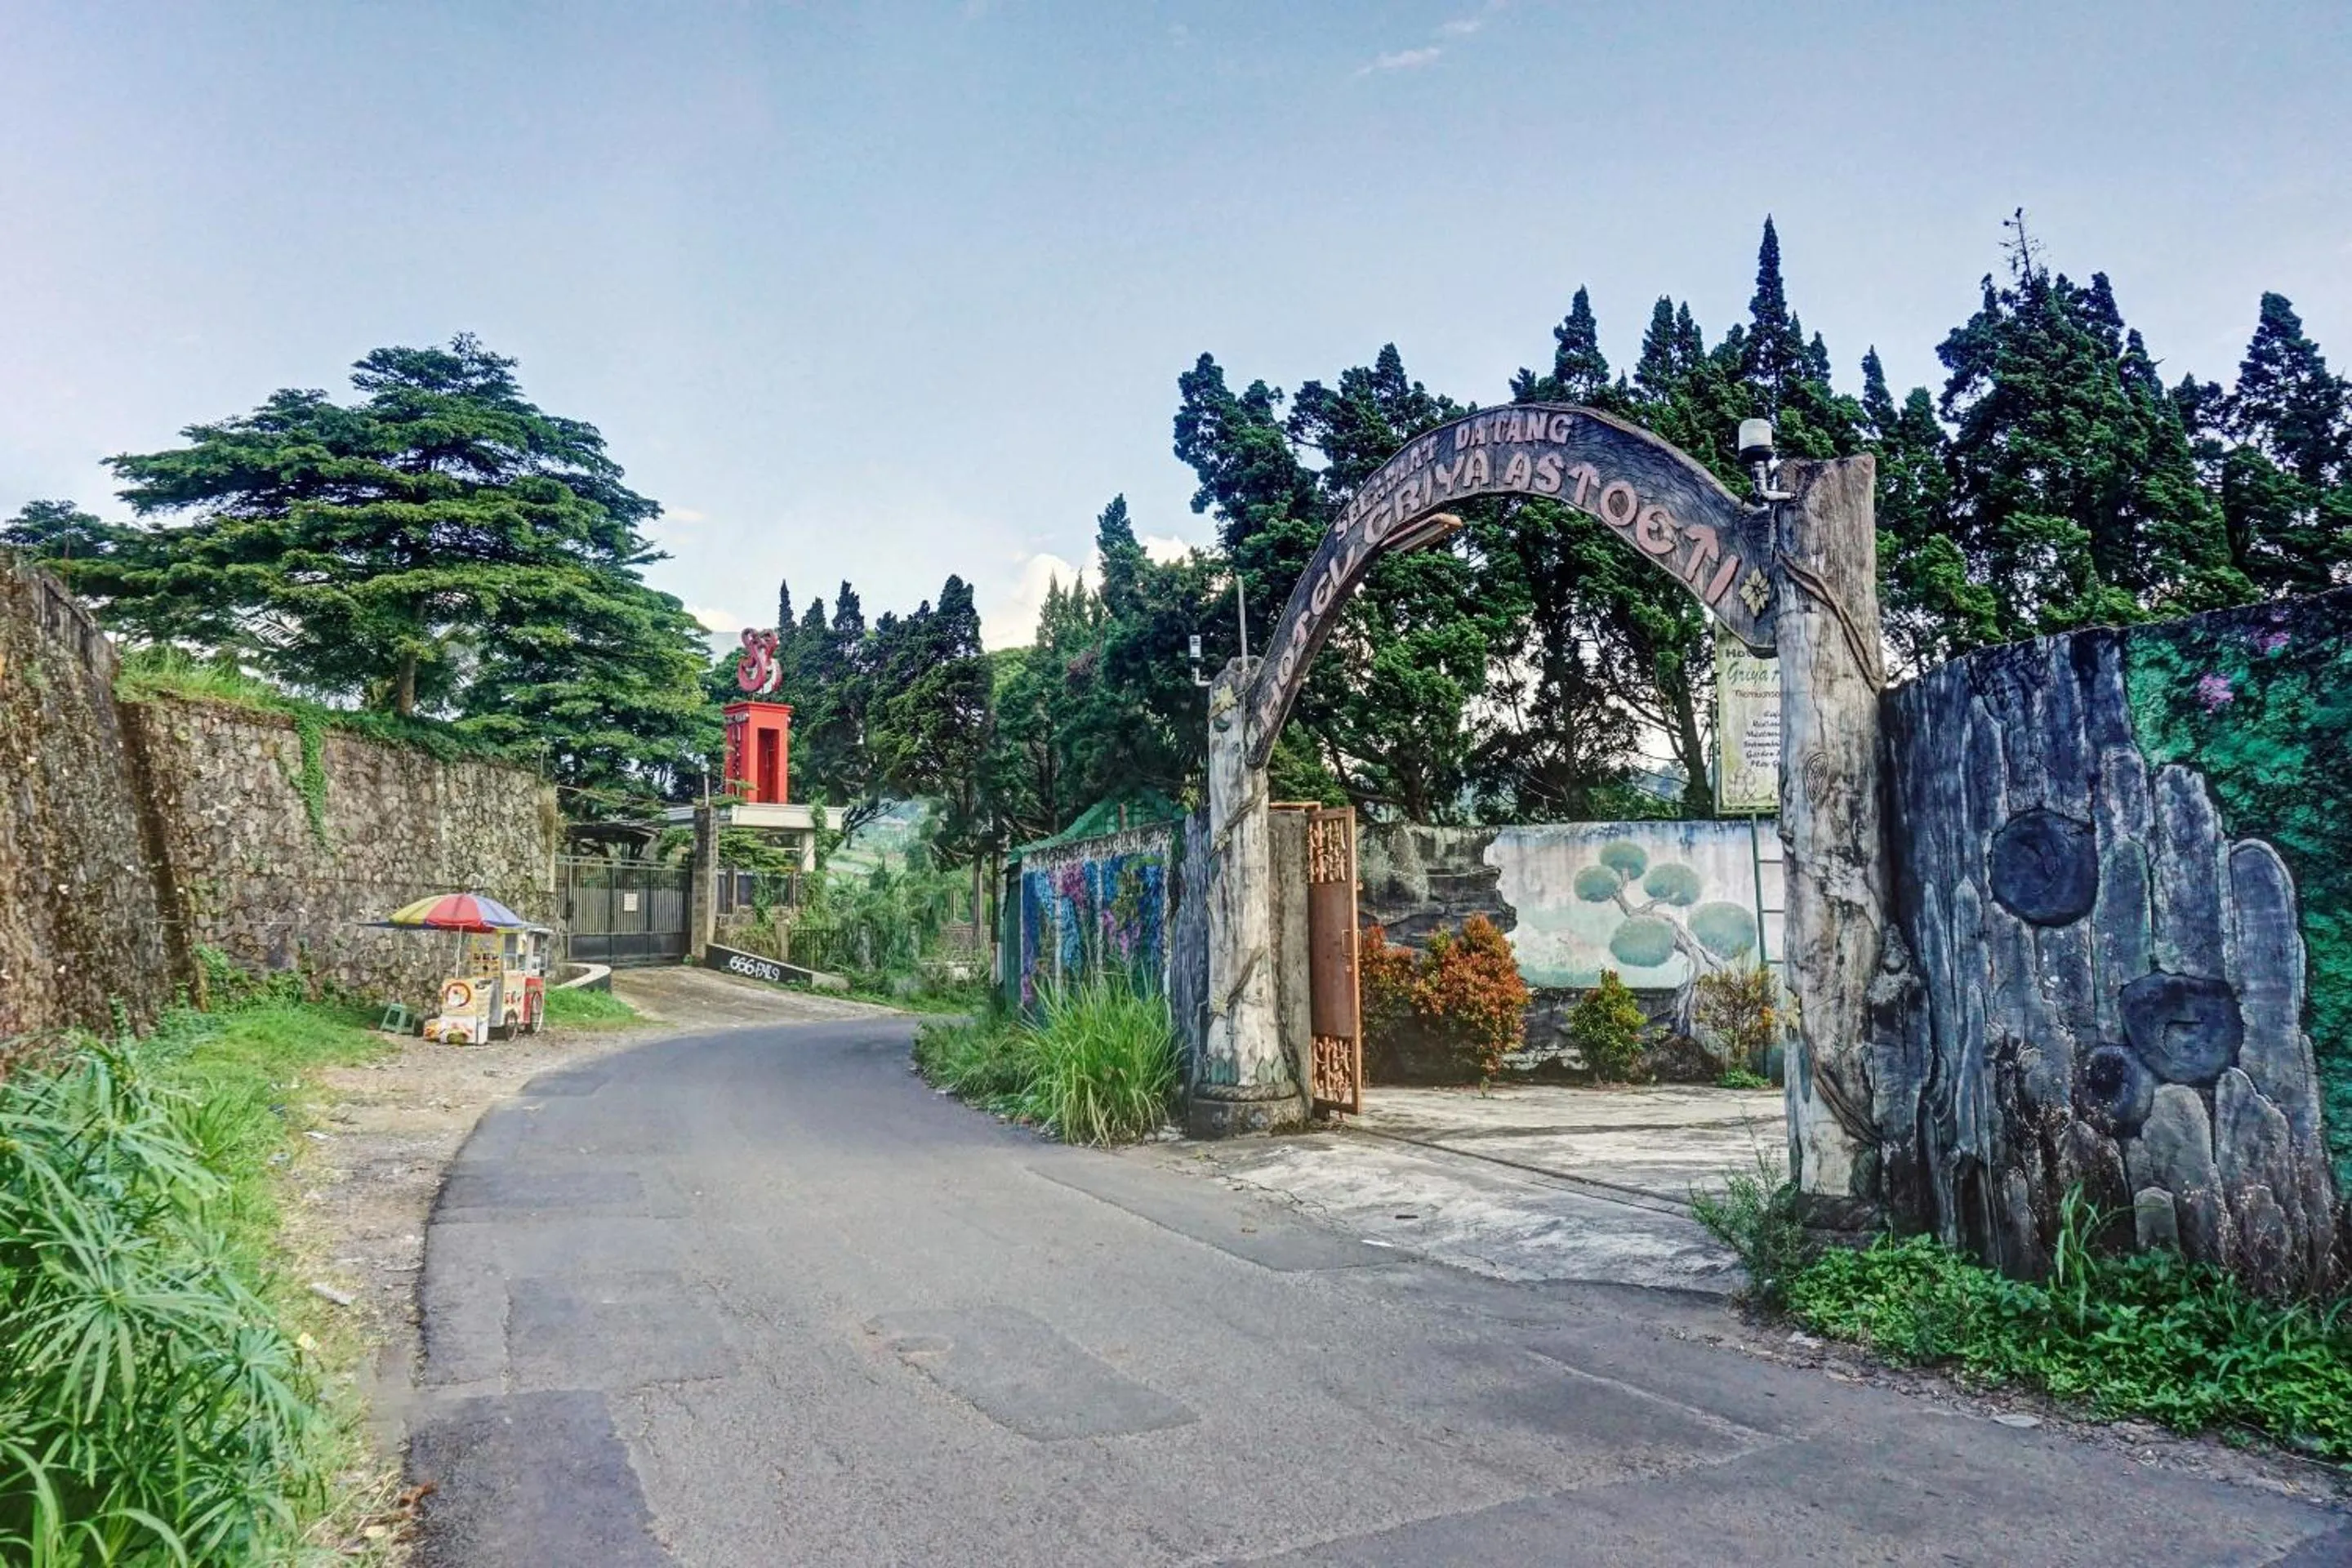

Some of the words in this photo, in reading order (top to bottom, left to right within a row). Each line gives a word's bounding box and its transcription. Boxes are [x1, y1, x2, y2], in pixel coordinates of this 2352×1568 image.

[1454, 408, 1573, 450] DATANG
[1363, 448, 1490, 544] GRIYA
[1503, 449, 1741, 605] ASTOETI
[1727, 661, 1769, 687] Griya
